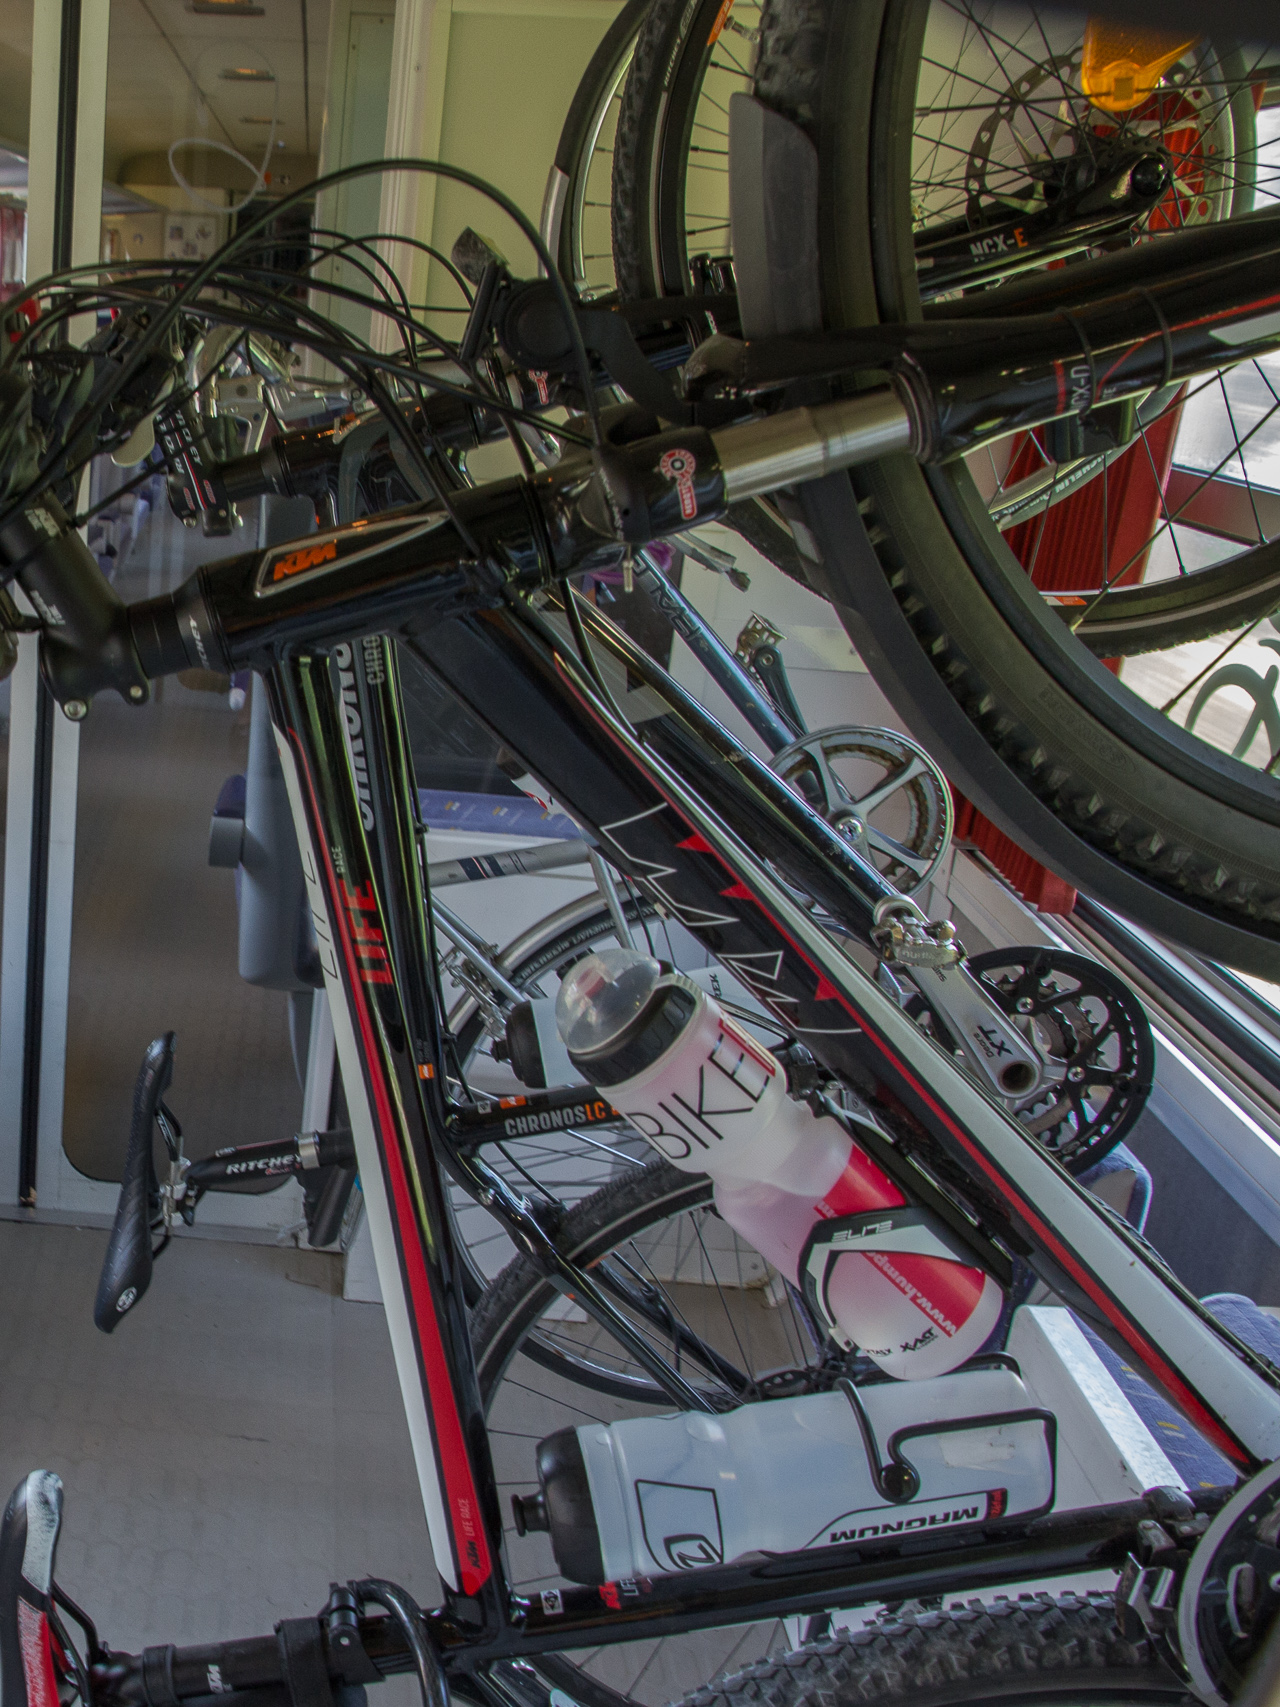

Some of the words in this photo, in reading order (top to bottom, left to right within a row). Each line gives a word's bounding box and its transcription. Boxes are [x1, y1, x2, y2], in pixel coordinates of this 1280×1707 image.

[970, 228, 1028, 255] NCX-E
[274, 543, 336, 581] KTM
[339, 879, 393, 984] LIFE
[977, 1025, 1013, 1056] XT
[458, 1498, 470, 1518] RACE
[462, 1520, 475, 1536] LIFE
[830, 1508, 979, 1543] MAGNUM
